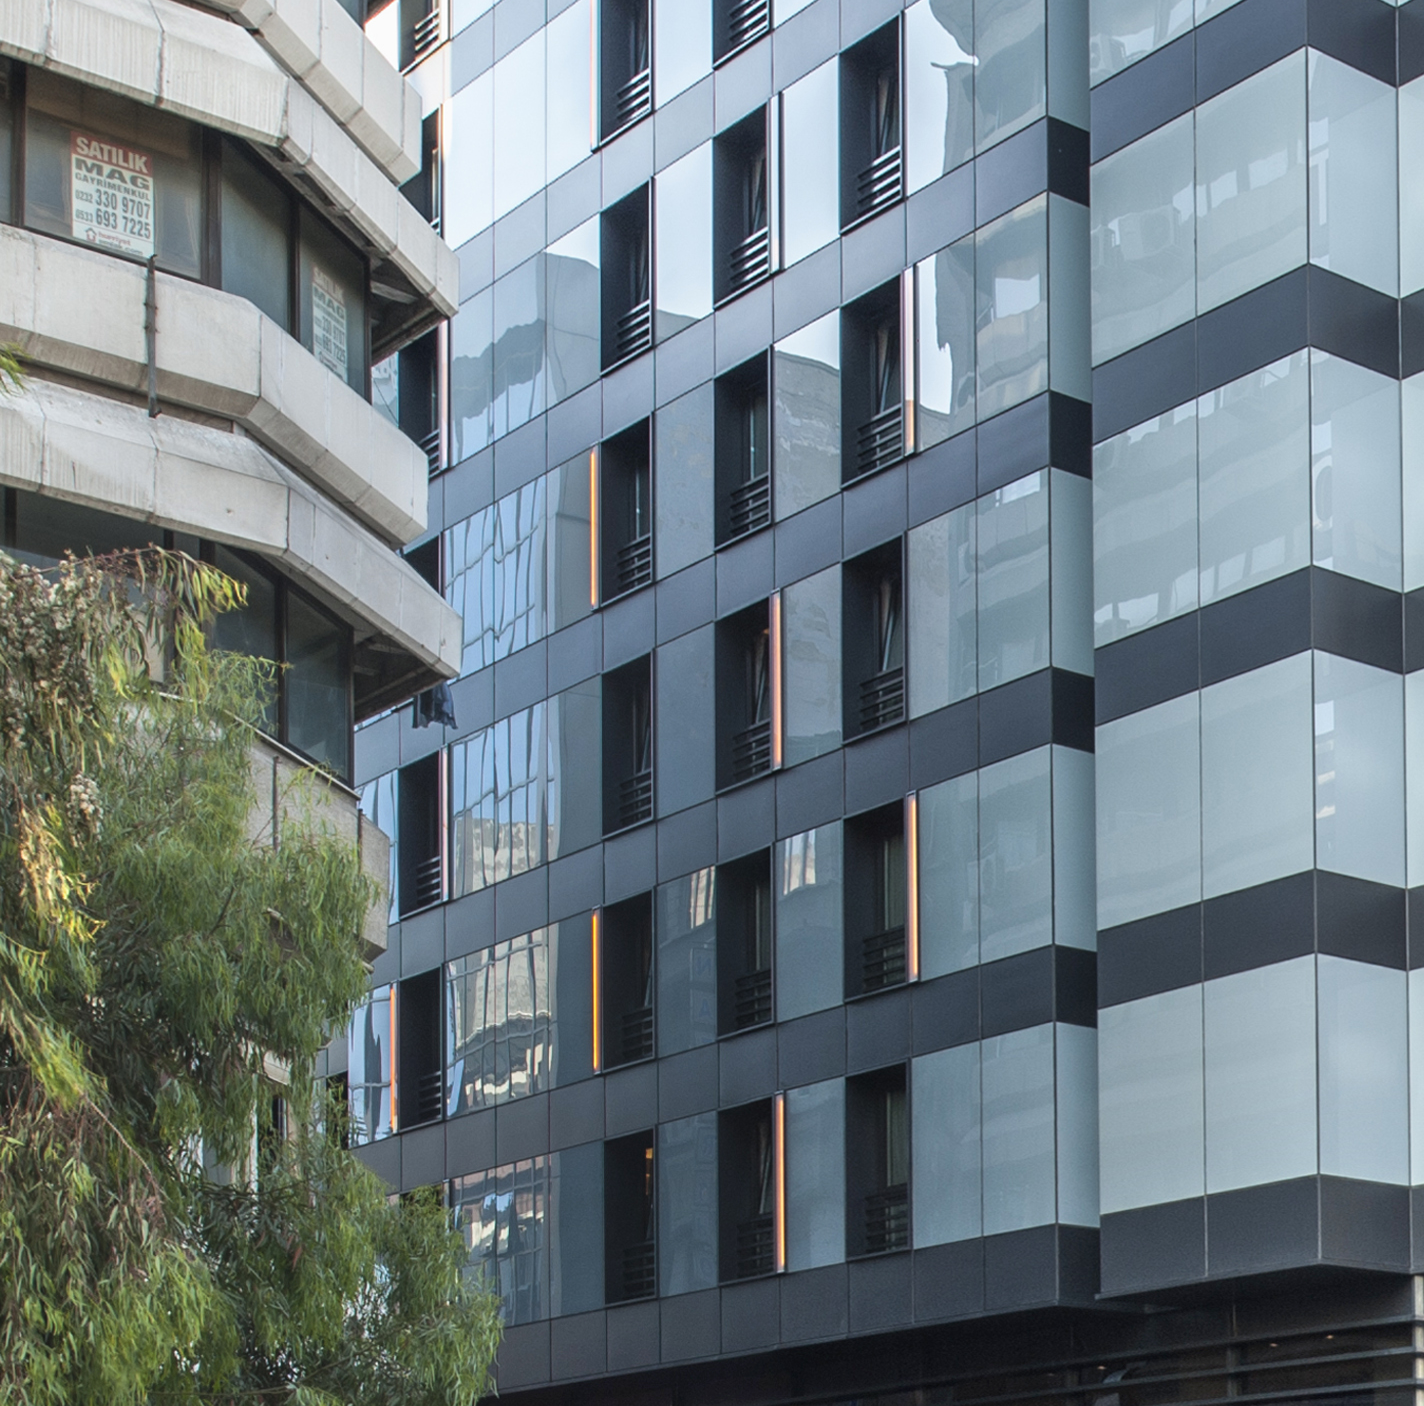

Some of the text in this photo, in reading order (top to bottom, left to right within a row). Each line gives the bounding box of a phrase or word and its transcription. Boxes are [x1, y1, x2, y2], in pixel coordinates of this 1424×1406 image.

[76, 136, 149, 174] SATILIK
[74, 156, 150, 191] MAG
[75, 172, 151, 201] GAYRİMENKUL
[95, 188, 118, 211] 330
[121, 196, 151, 220] 9707
[95, 207, 118, 230] 693
[122, 215, 151, 240] 7225
